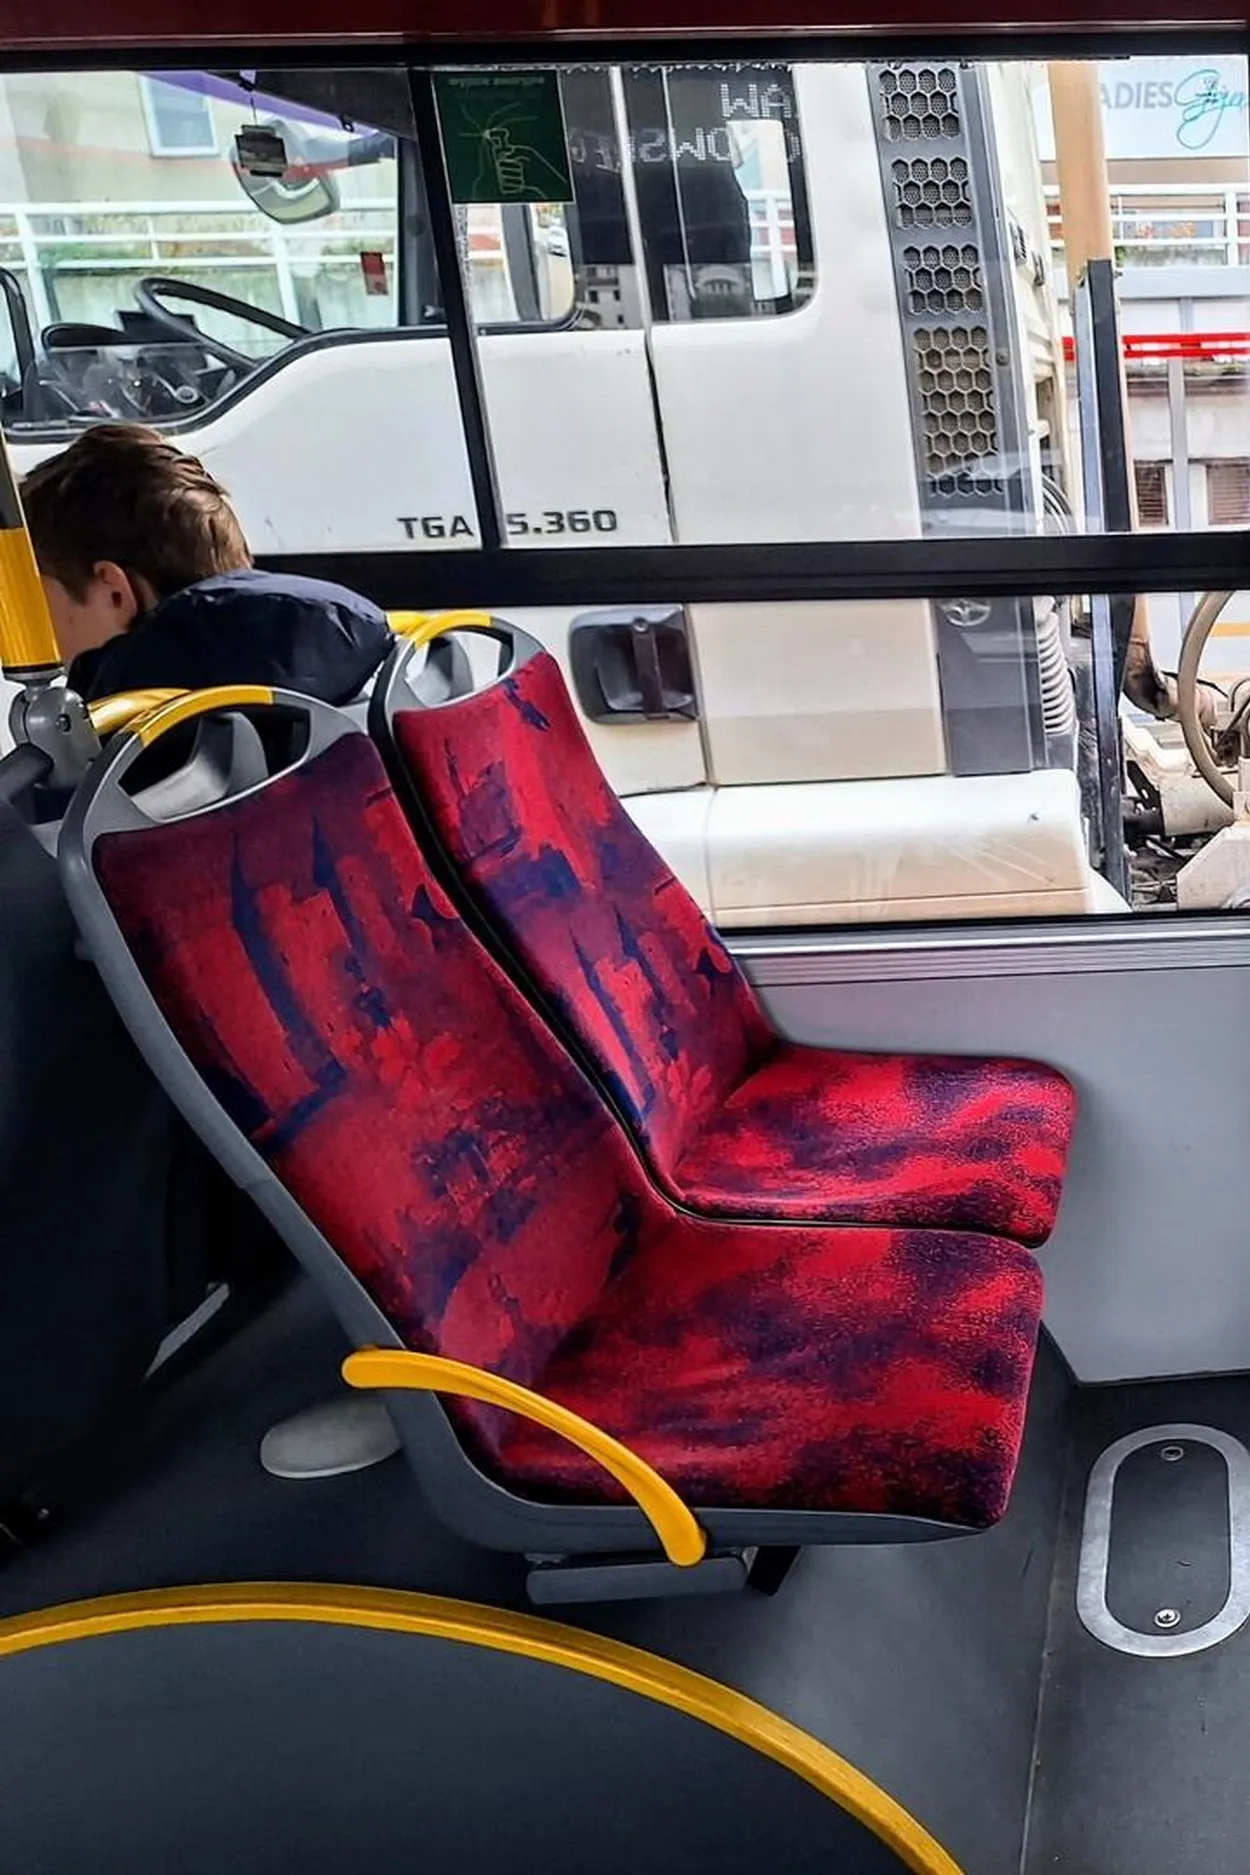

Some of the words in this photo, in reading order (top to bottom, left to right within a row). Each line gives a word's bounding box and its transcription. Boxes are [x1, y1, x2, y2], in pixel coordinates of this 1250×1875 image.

[1099, 79, 1173, 110] ADIES
[396, 514, 474, 540] TGA
[505, 509, 618, 536] 5.360
